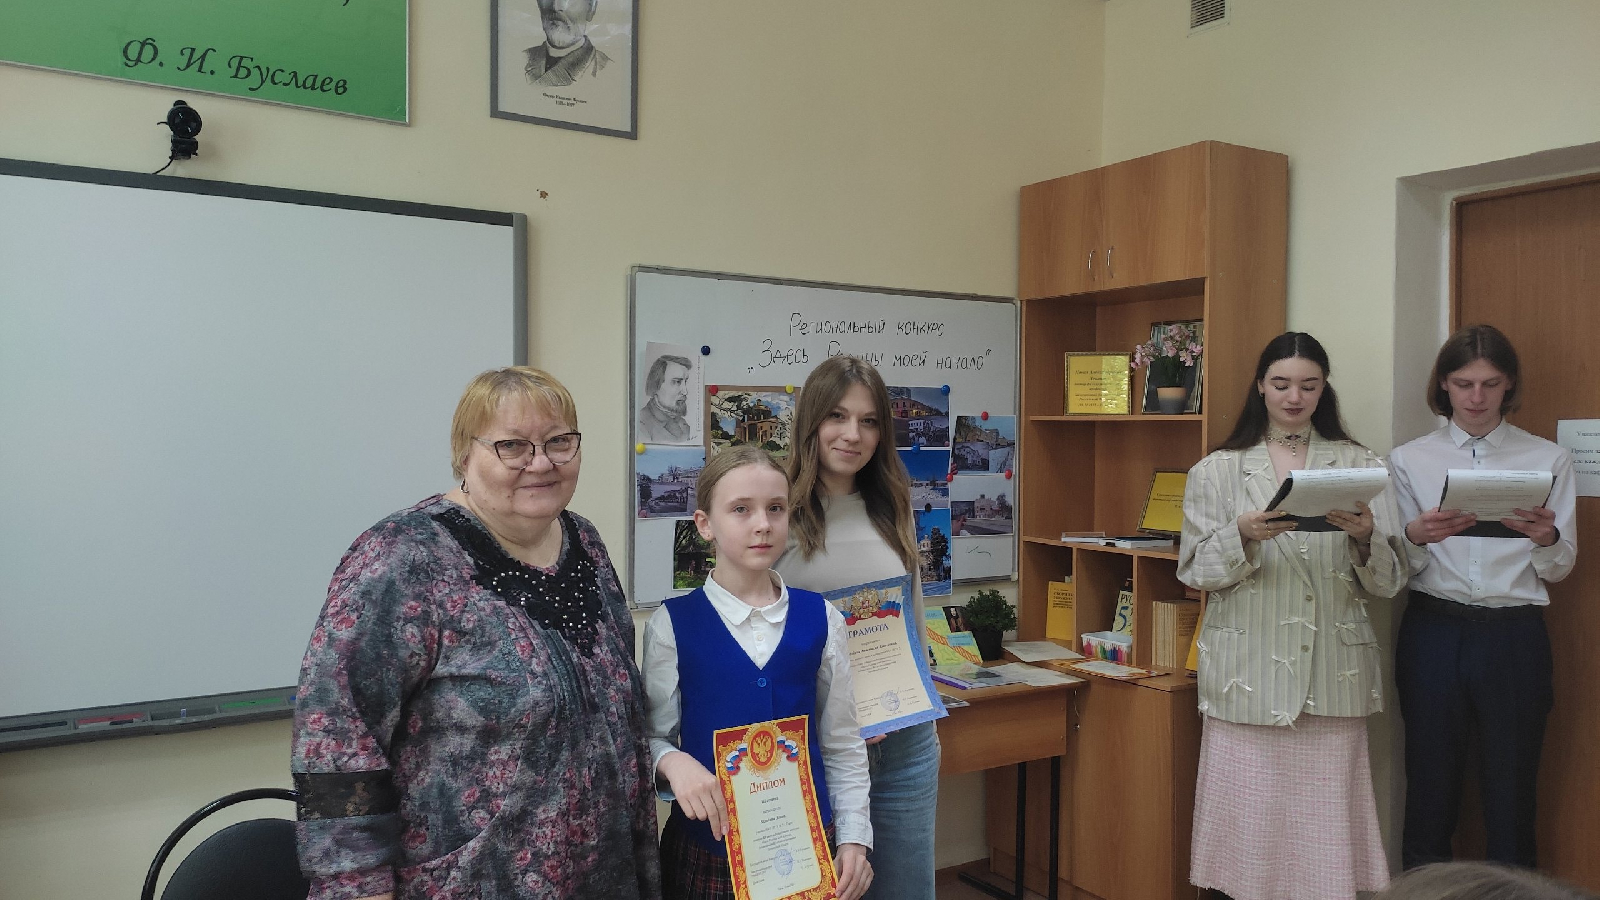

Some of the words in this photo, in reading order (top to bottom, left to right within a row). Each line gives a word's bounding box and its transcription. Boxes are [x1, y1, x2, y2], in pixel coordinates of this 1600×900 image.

[122, 37, 164, 68] Ф.
[176, 46, 217, 75] И.
[227, 55, 348, 96] Буслаев
[896, 320, 945, 337] конкурс
[892, 350, 929, 368] моей
[1116, 605, 1130, 632] 5
[847, 623, 889, 639] ГРАМОТА
